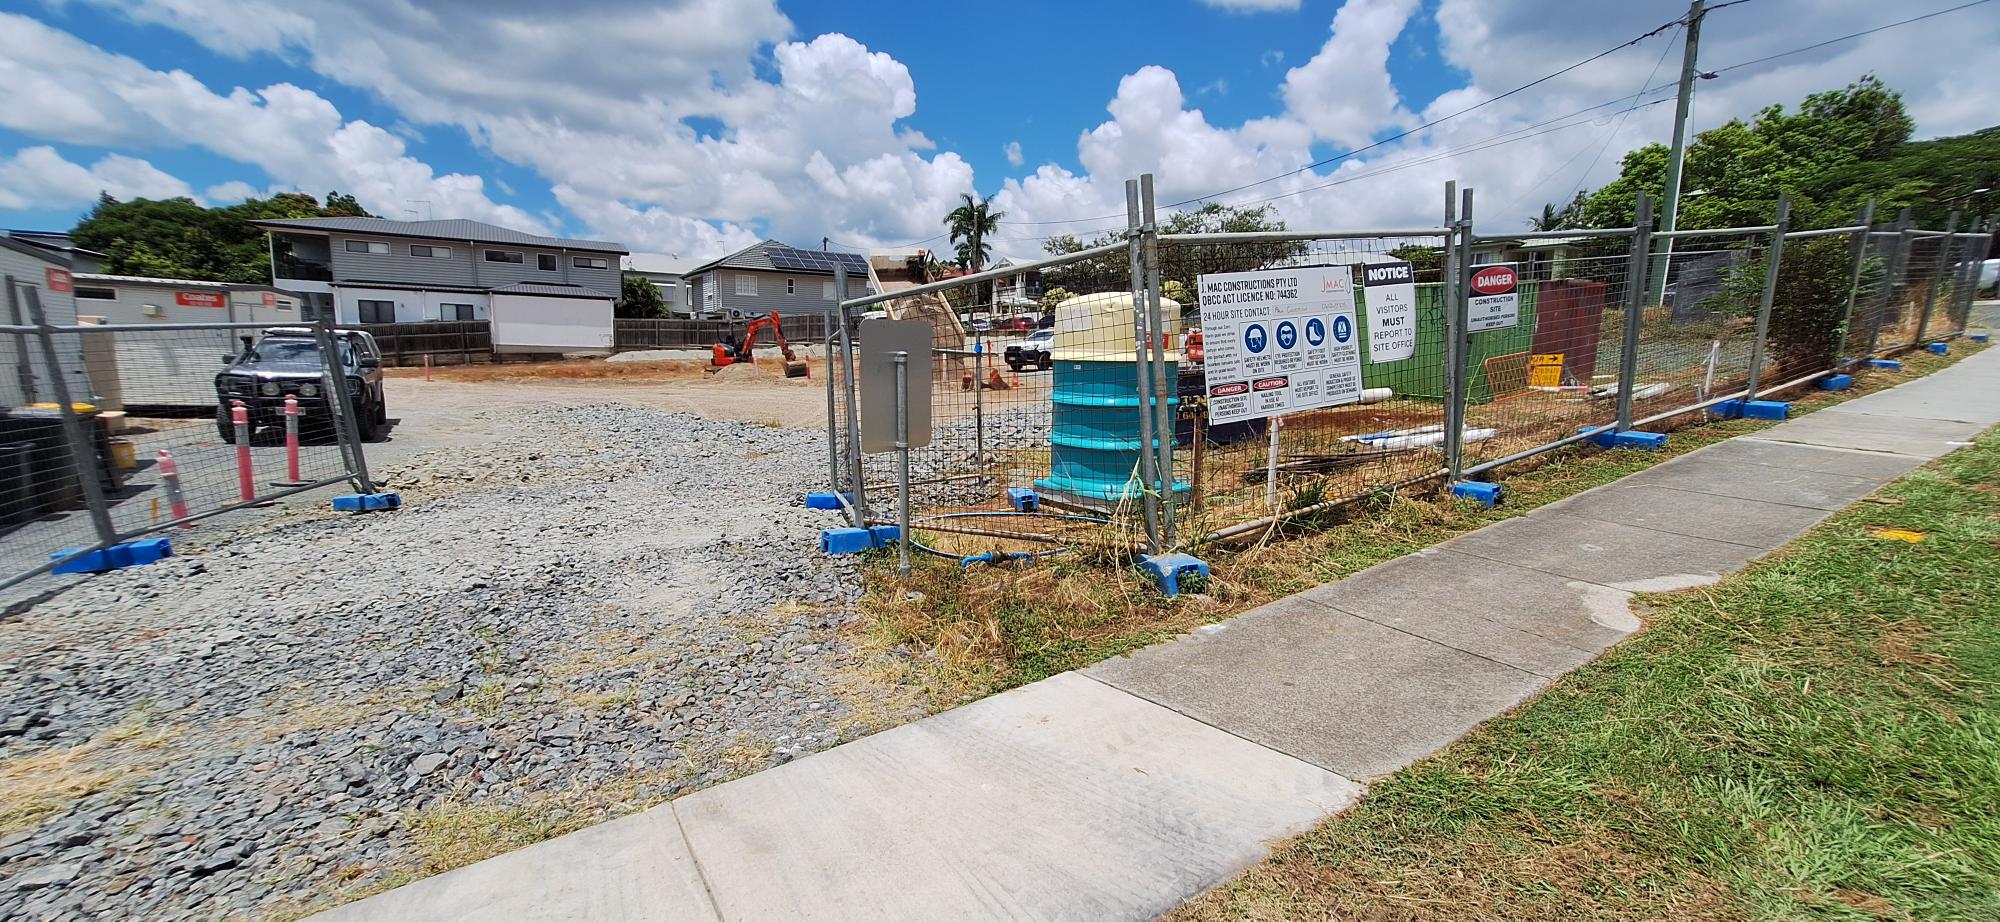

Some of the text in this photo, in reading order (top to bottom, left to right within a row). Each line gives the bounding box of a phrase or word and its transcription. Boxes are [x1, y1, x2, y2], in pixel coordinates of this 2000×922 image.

[1368, 266, 1409, 281] NOTICE
[1208, 282, 1222, 292] MAC
[1223, 278, 1275, 292] CONSTRUCTIONS
[1276, 278, 1287, 287] PTY
[1287, 277, 1298, 287] LTD
[1477, 274, 1512, 288] DANGER
[1222, 293, 1235, 304] ACT
[1237, 292, 1264, 303] LICENCE
[1265, 290, 1276, 301] NO:
[1276, 289, 1298, 300] 744362
[1386, 293, 1398, 302] ALL
[1474, 296, 1513, 305] CONSTRUCTION
[1376, 304, 1408, 314] VISITORS
[1203, 312, 1211, 321] 24
[1212, 310, 1229, 320] HOUR
[1231, 309, 1243, 318] SITE
[1382, 317, 1405, 327] MUST
[1374, 328, 1412, 340] REPORT TO
[1374, 339, 1413, 352] SITE OFFICE
[1258, 380, 1283, 388] CAUTION
[1218, 386, 1242, 394] DANGER
[1213, 397, 1240, 405] CONSTRUCTION
